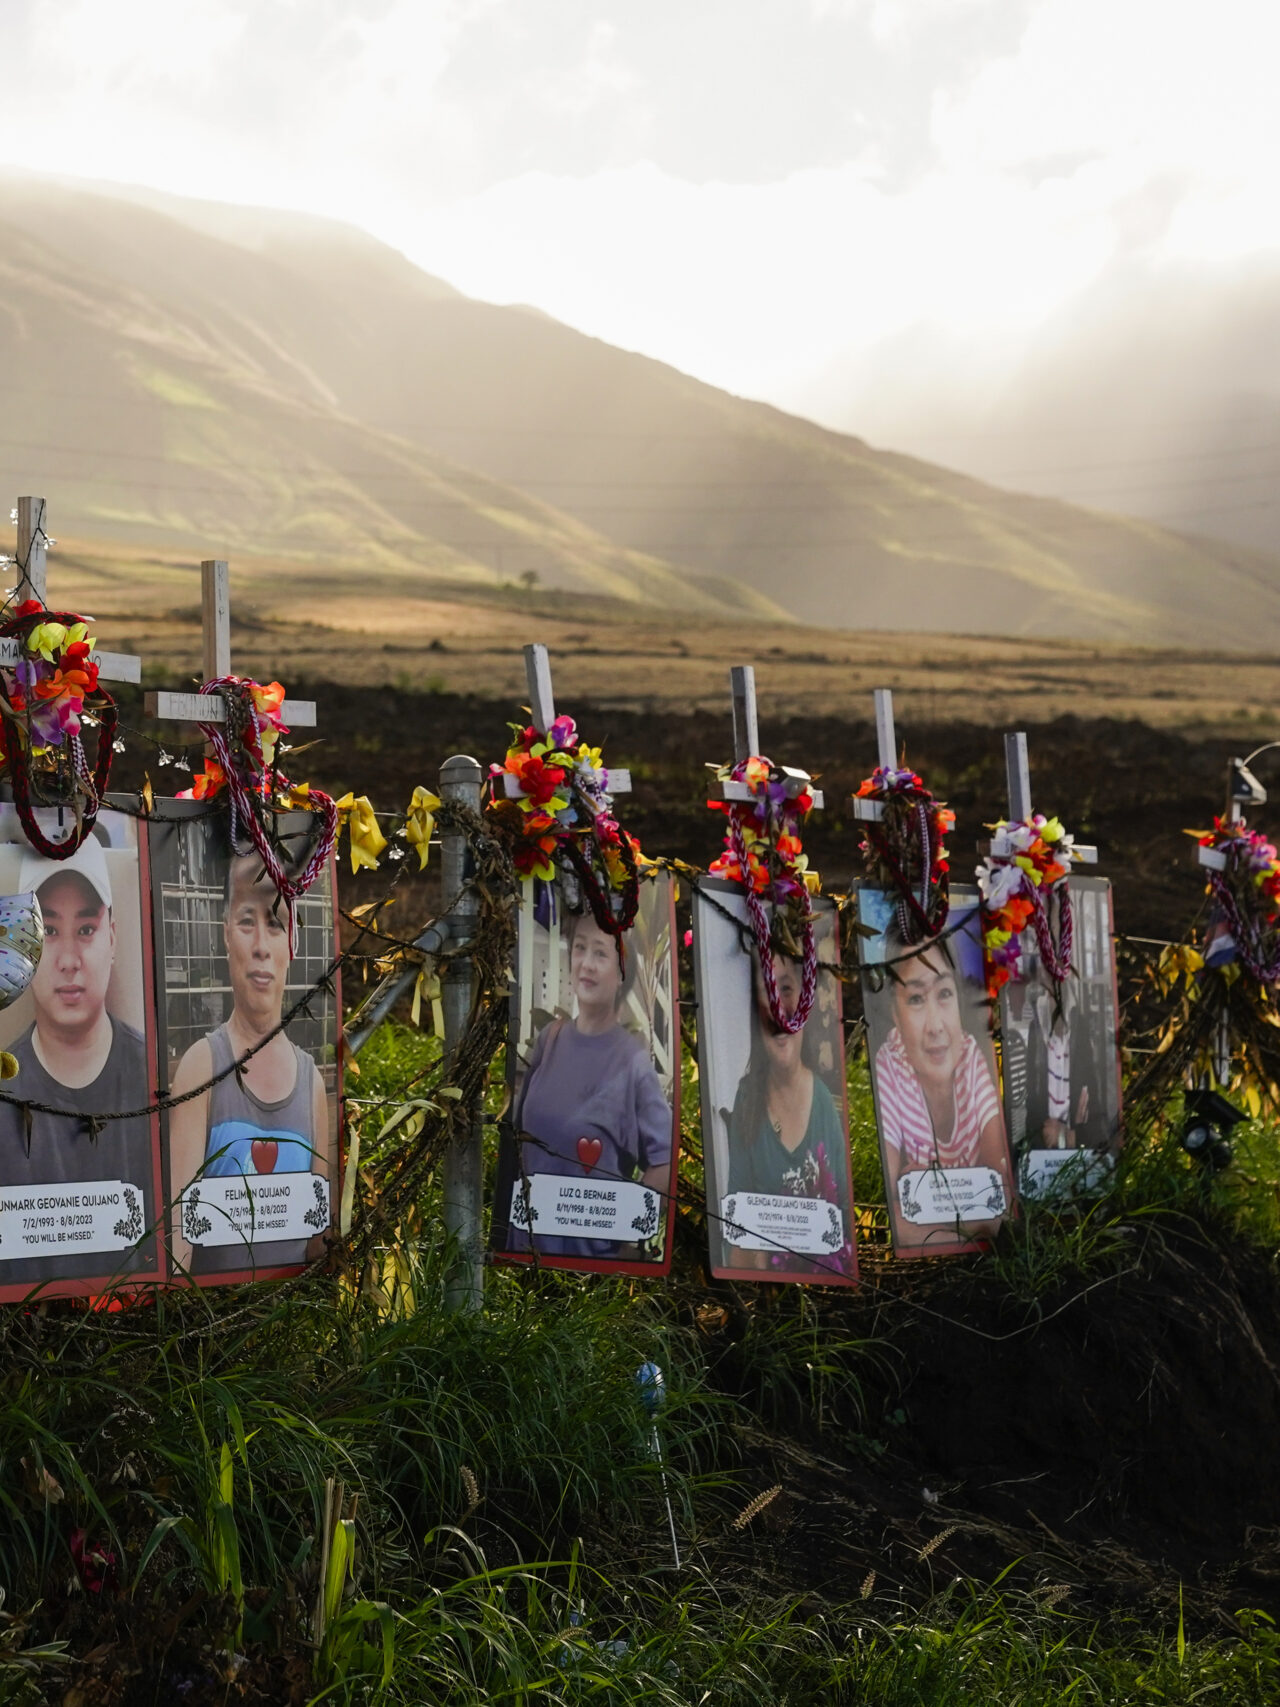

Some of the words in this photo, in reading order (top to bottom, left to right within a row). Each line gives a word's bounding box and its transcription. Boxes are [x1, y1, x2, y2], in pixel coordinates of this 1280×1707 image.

[225, 1188, 257, 1200] FELIMN
[258, 1186, 290, 1198] QUIJANO
[559, 1187, 573, 1197] LUZ
[583, 1189, 616, 1201] BERNABE
[37, 1196, 80, 1209] GEOVANIE
[82, 1194, 119, 1207] QUIJANO
[229, 1208, 255, 1218] 7/5/196
[260, 1204, 287, 1215] 8/8/2023
[23, 1217, 55, 1229] 7/2/1993
[60, 1214, 93, 1227] 8/8/2023
[258, 1221, 264, 1229] BE
[570, 1218, 582, 1226] WILL
[584, 1219, 591, 1227] BE
[41, 1234, 56, 1243] WILL
[58, 1233, 66, 1241] BE
[67, 1230, 95, 1241] MISSED."
